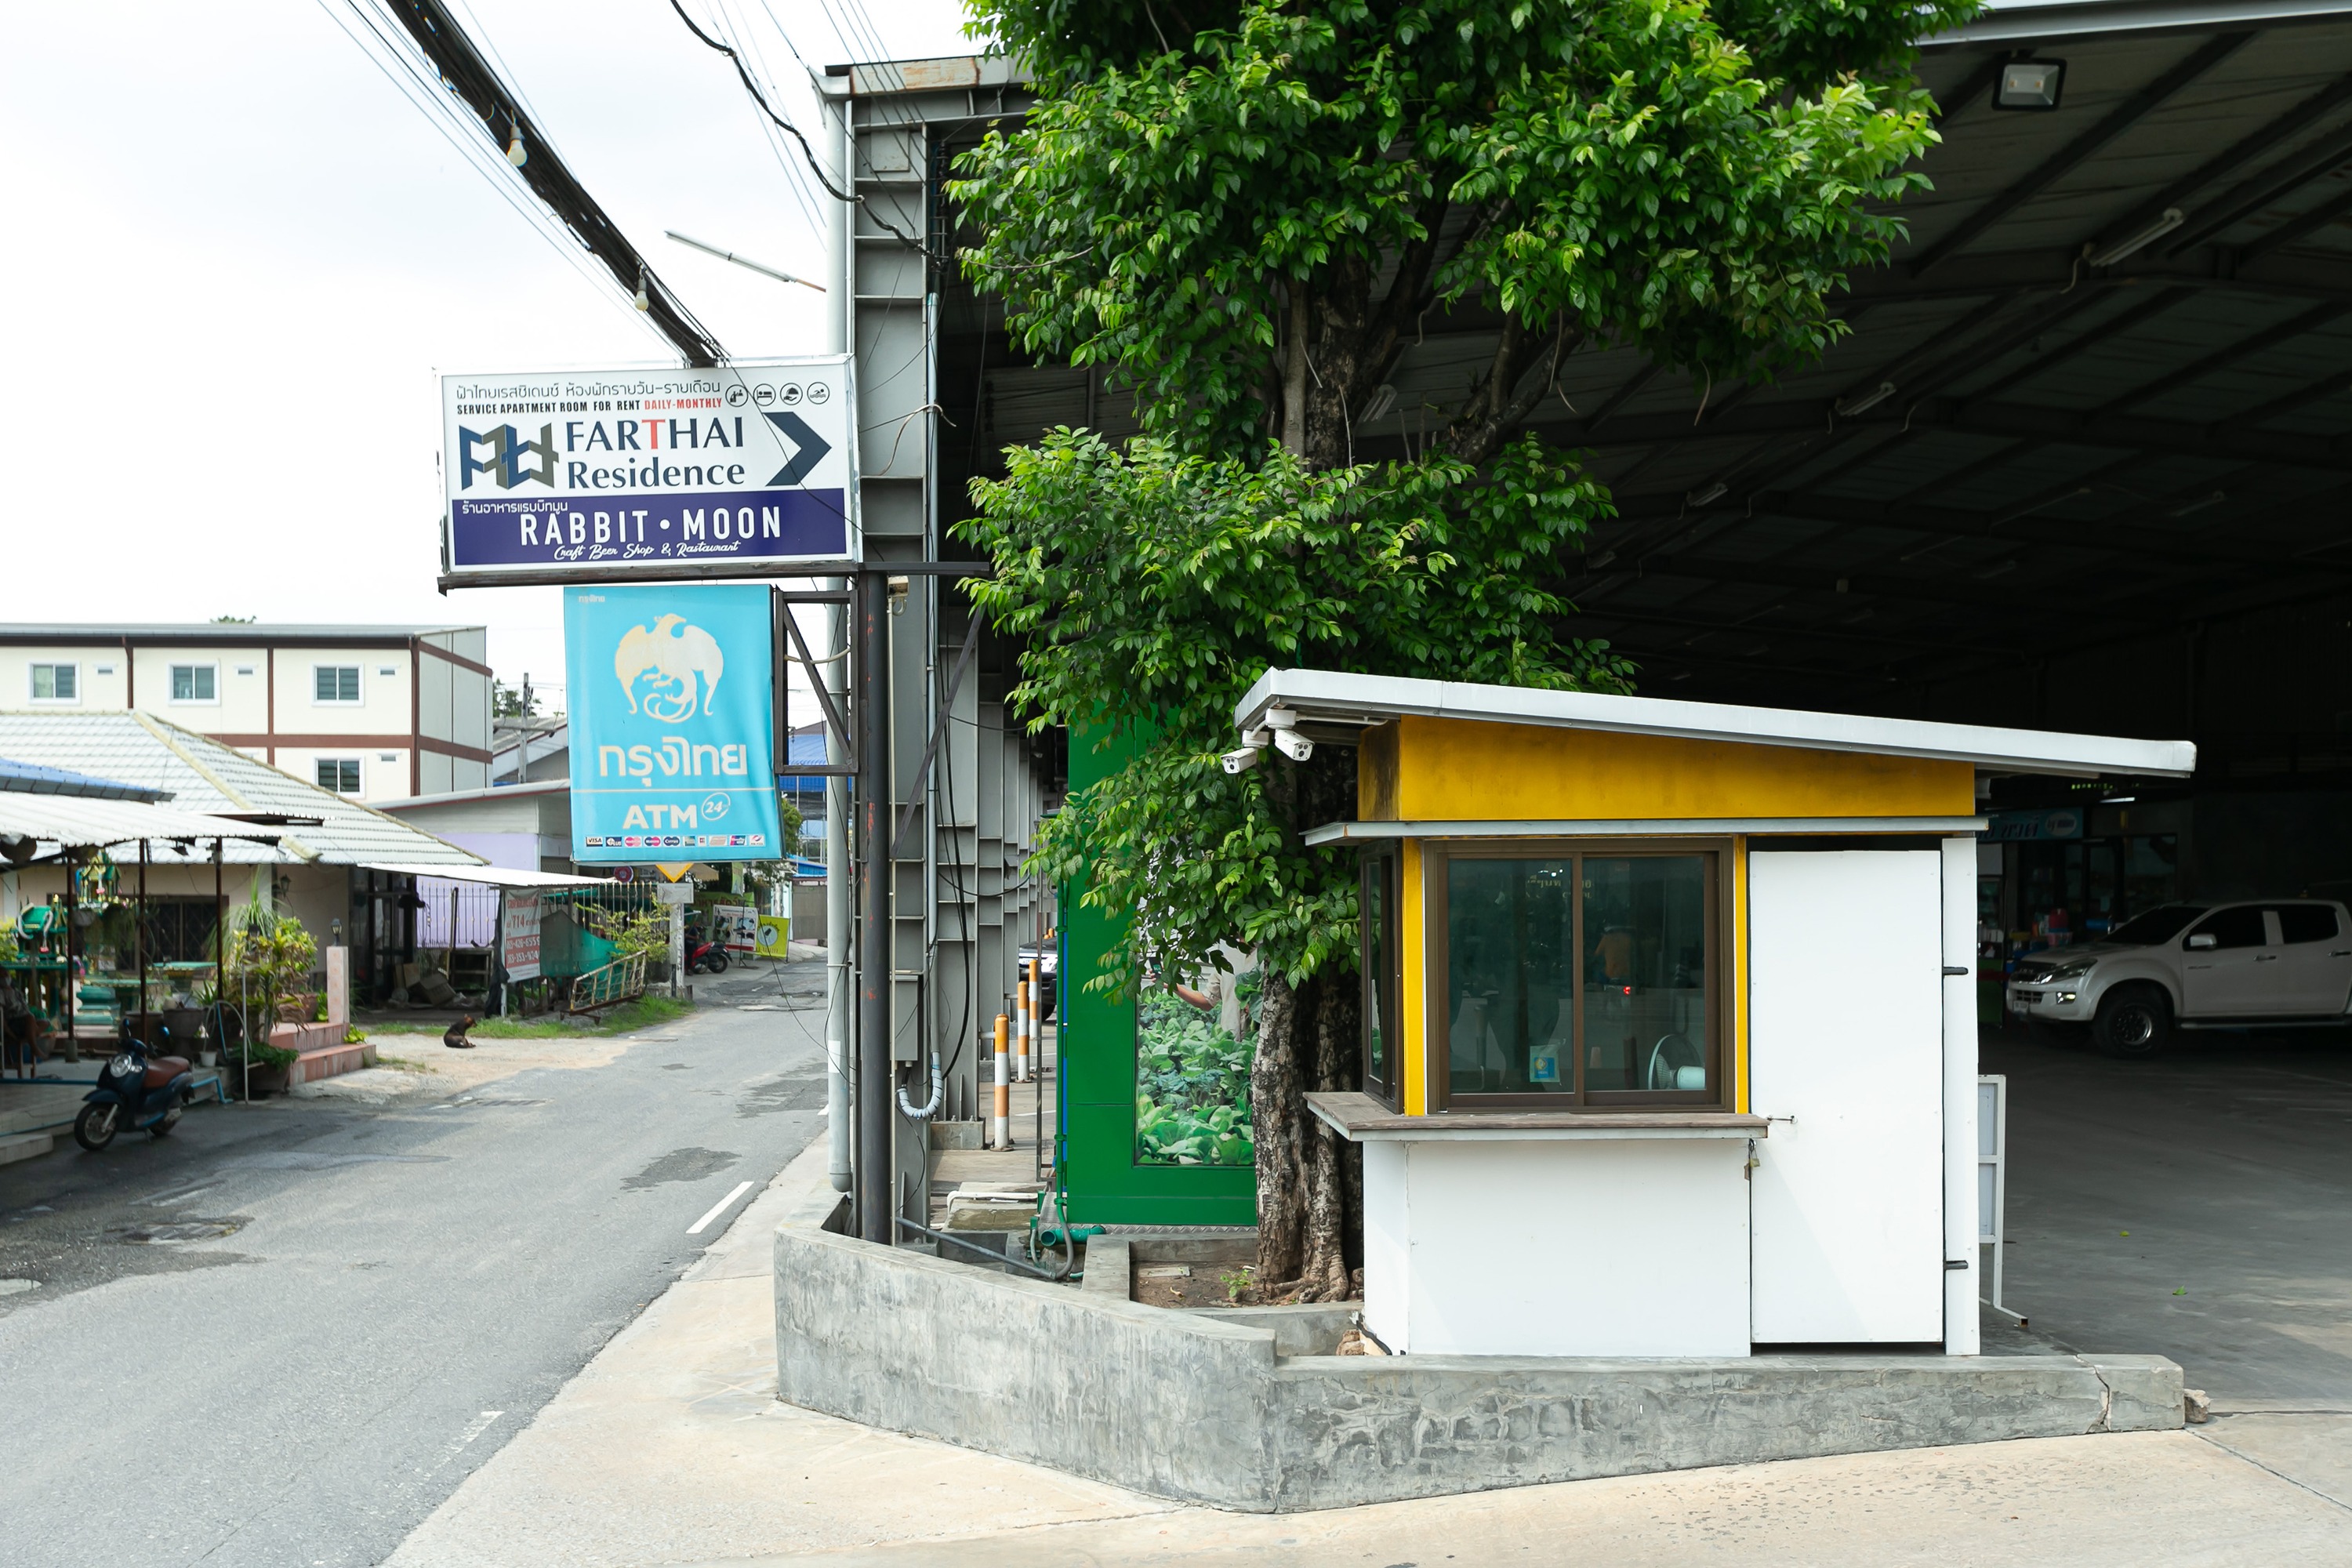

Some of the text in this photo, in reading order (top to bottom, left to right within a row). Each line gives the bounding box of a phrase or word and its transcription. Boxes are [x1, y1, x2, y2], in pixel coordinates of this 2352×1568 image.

[457, 397, 722, 415] SERVICE APARTMENT ROOM FOR RENT DAILY-MONTHLY
[566, 416, 743, 452] FARTHAI
[568, 456, 745, 489] Residence
[520, 506, 781, 546] RABBIT MOON
[554, 545, 586, 561] Craft
[589, 544, 618, 561] Beer
[622, 543, 655, 559] Shop
[661, 542, 671, 557] &
[599, 736, 748, 787] กรุงไทย
[622, 800, 723, 829] ATM 24
